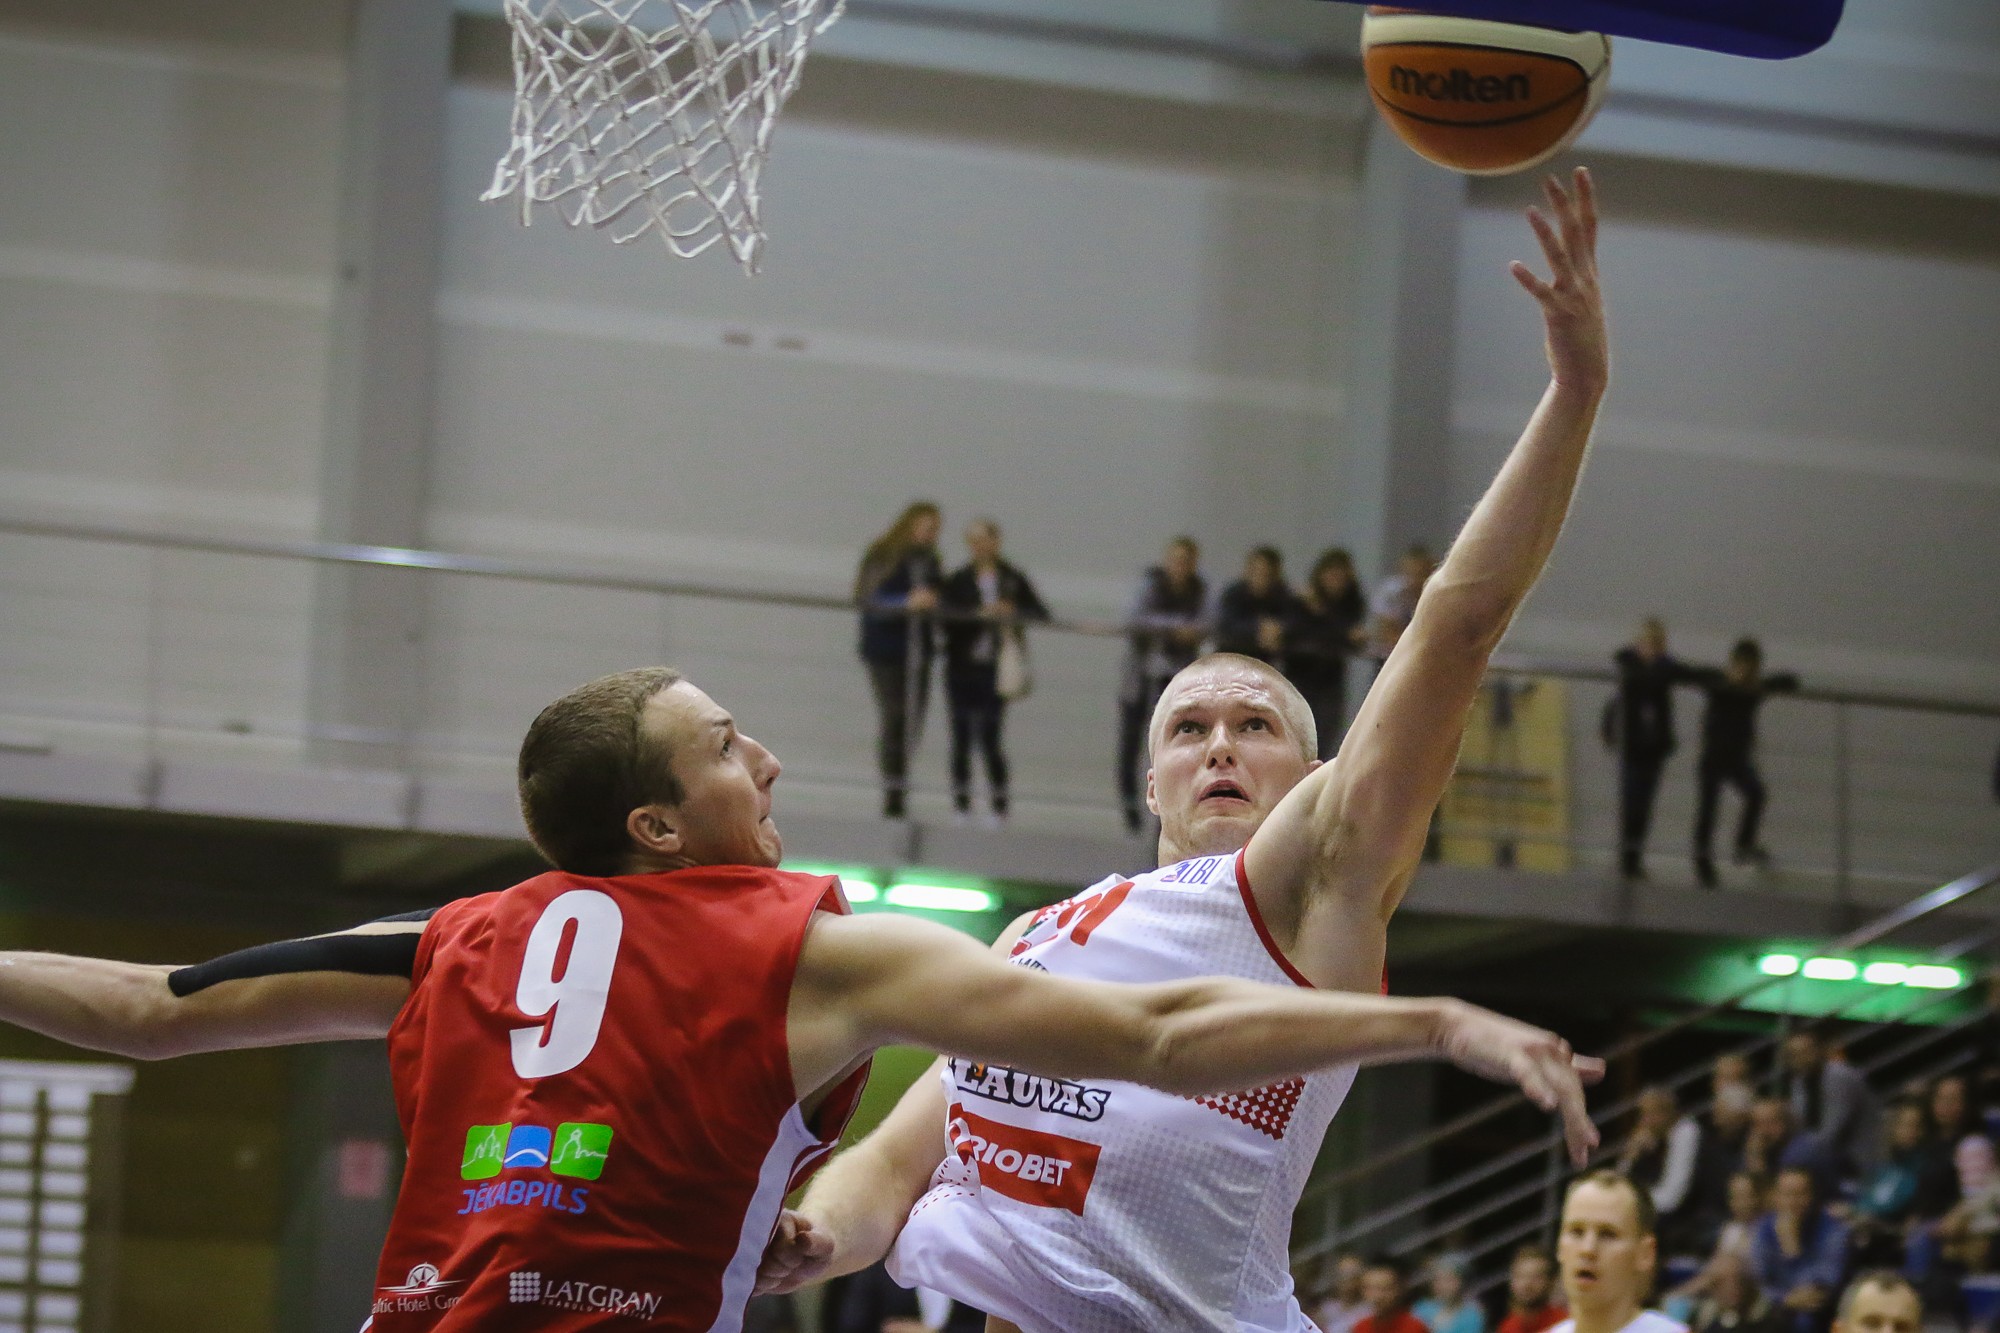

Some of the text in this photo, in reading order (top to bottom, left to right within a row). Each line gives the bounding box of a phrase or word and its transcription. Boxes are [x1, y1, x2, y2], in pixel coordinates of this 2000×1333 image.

[1391, 65, 1529, 102] molten
[1178, 858, 1222, 885] LBL
[510, 889, 624, 1079] 9
[950, 1058, 1111, 1122] LAUVAS
[954, 1134, 1072, 1186] RIOBET
[457, 1179, 589, 1215] JĒKABPILS
[371, 1297, 394, 1314] altic
[397, 1295, 432, 1312] Hotel
[544, 1280, 662, 1314] LATGRAN
